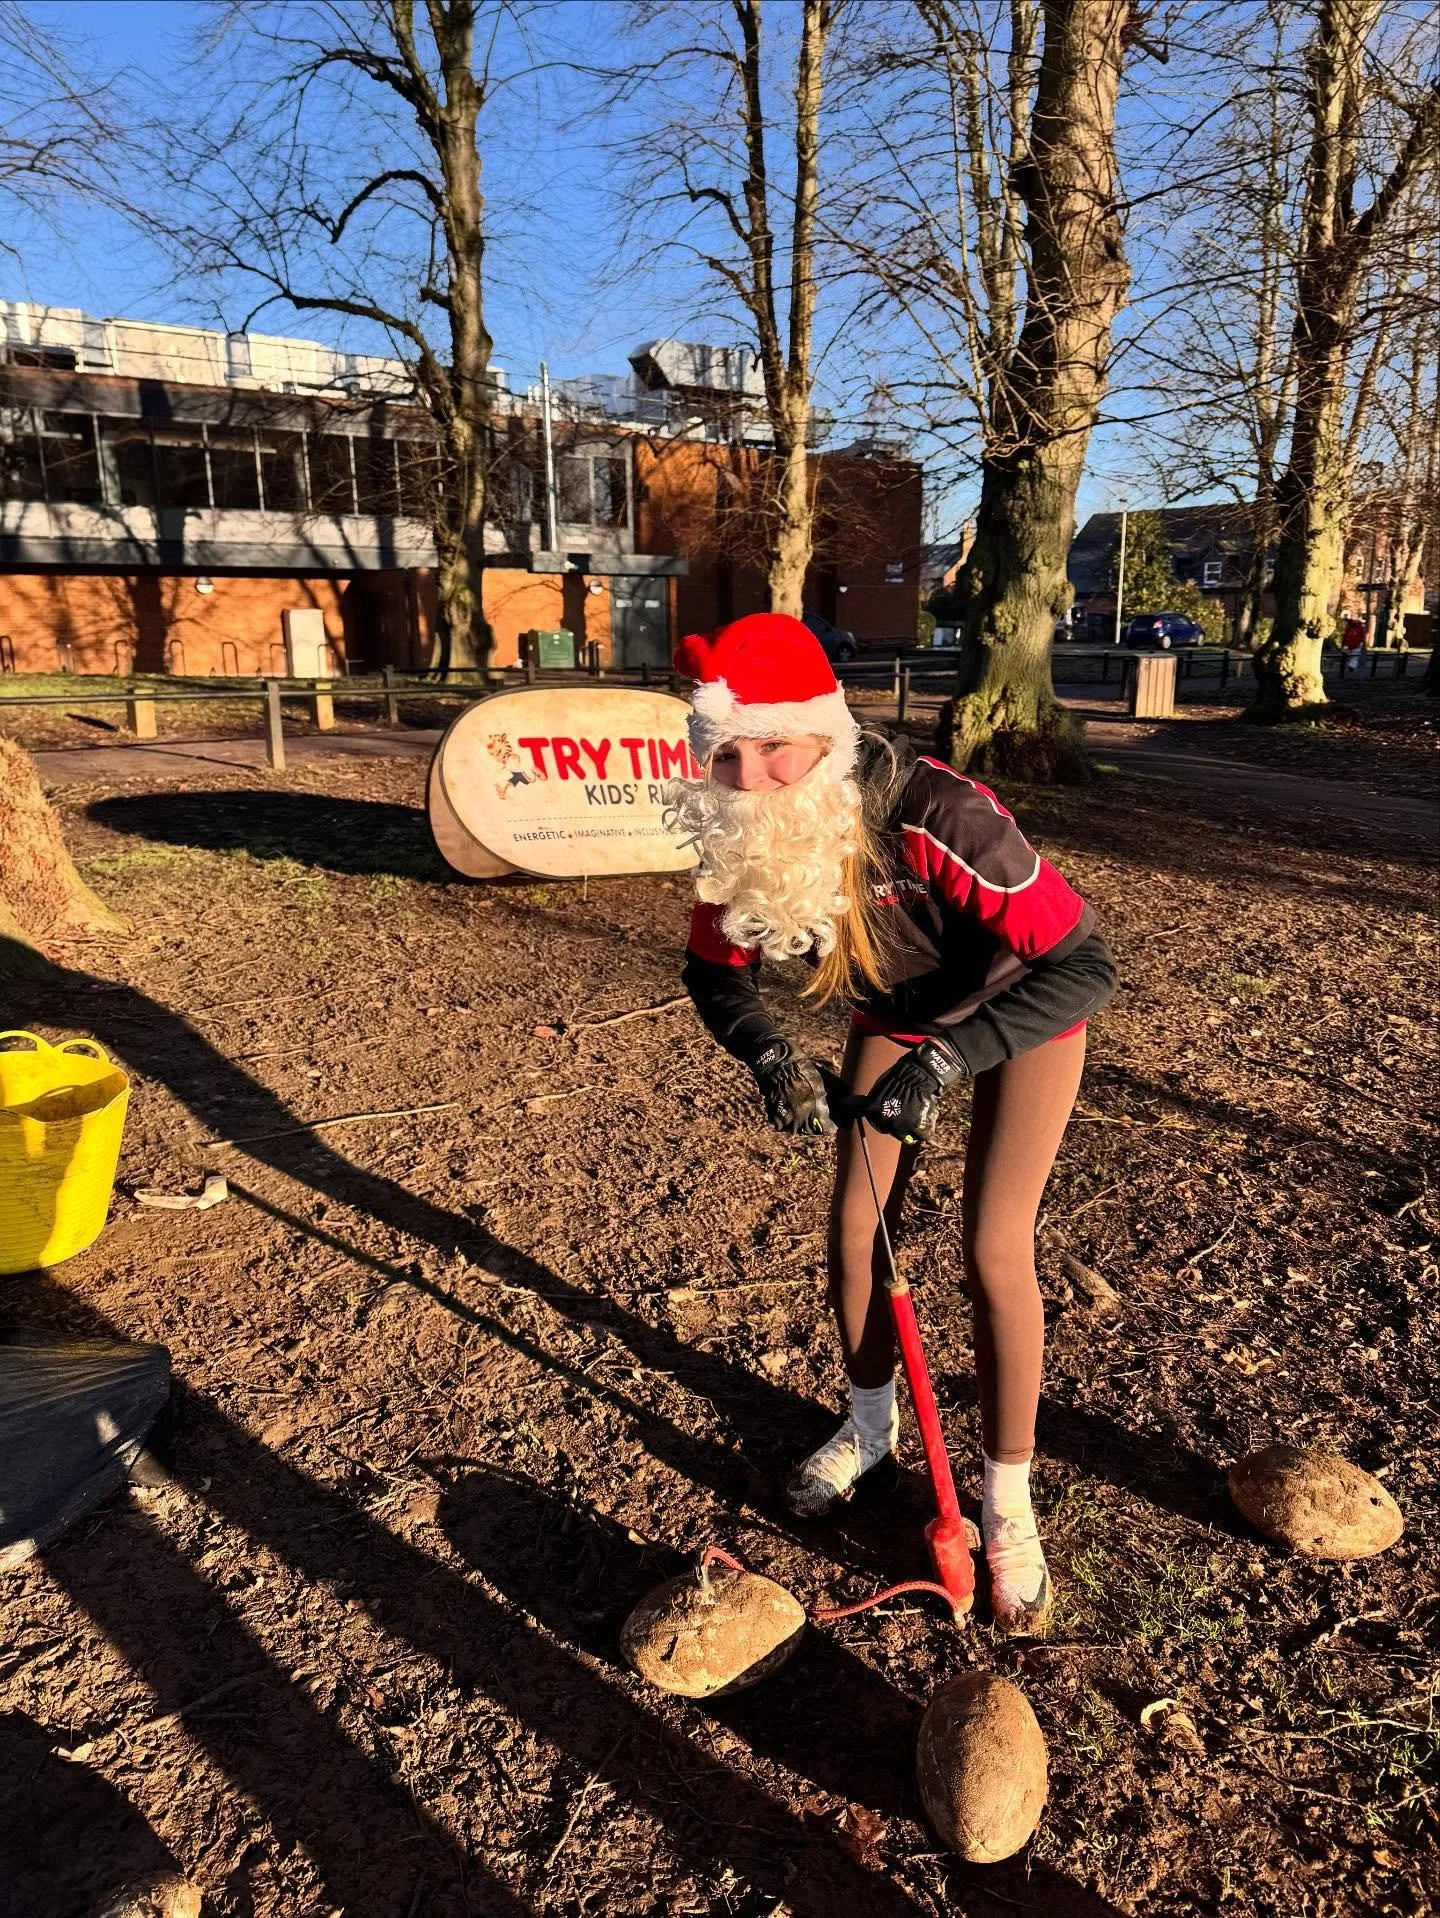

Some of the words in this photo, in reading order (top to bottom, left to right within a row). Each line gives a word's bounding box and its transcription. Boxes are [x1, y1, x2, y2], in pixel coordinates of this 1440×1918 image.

[518, 737, 611, 781] TRY
[585, 784, 639, 806] KIDS'
[513, 830, 567, 842] ENERGETIC
[575, 828, 626, 838] IMAGINATIVE
[930, 1049, 951, 1073] WATER
